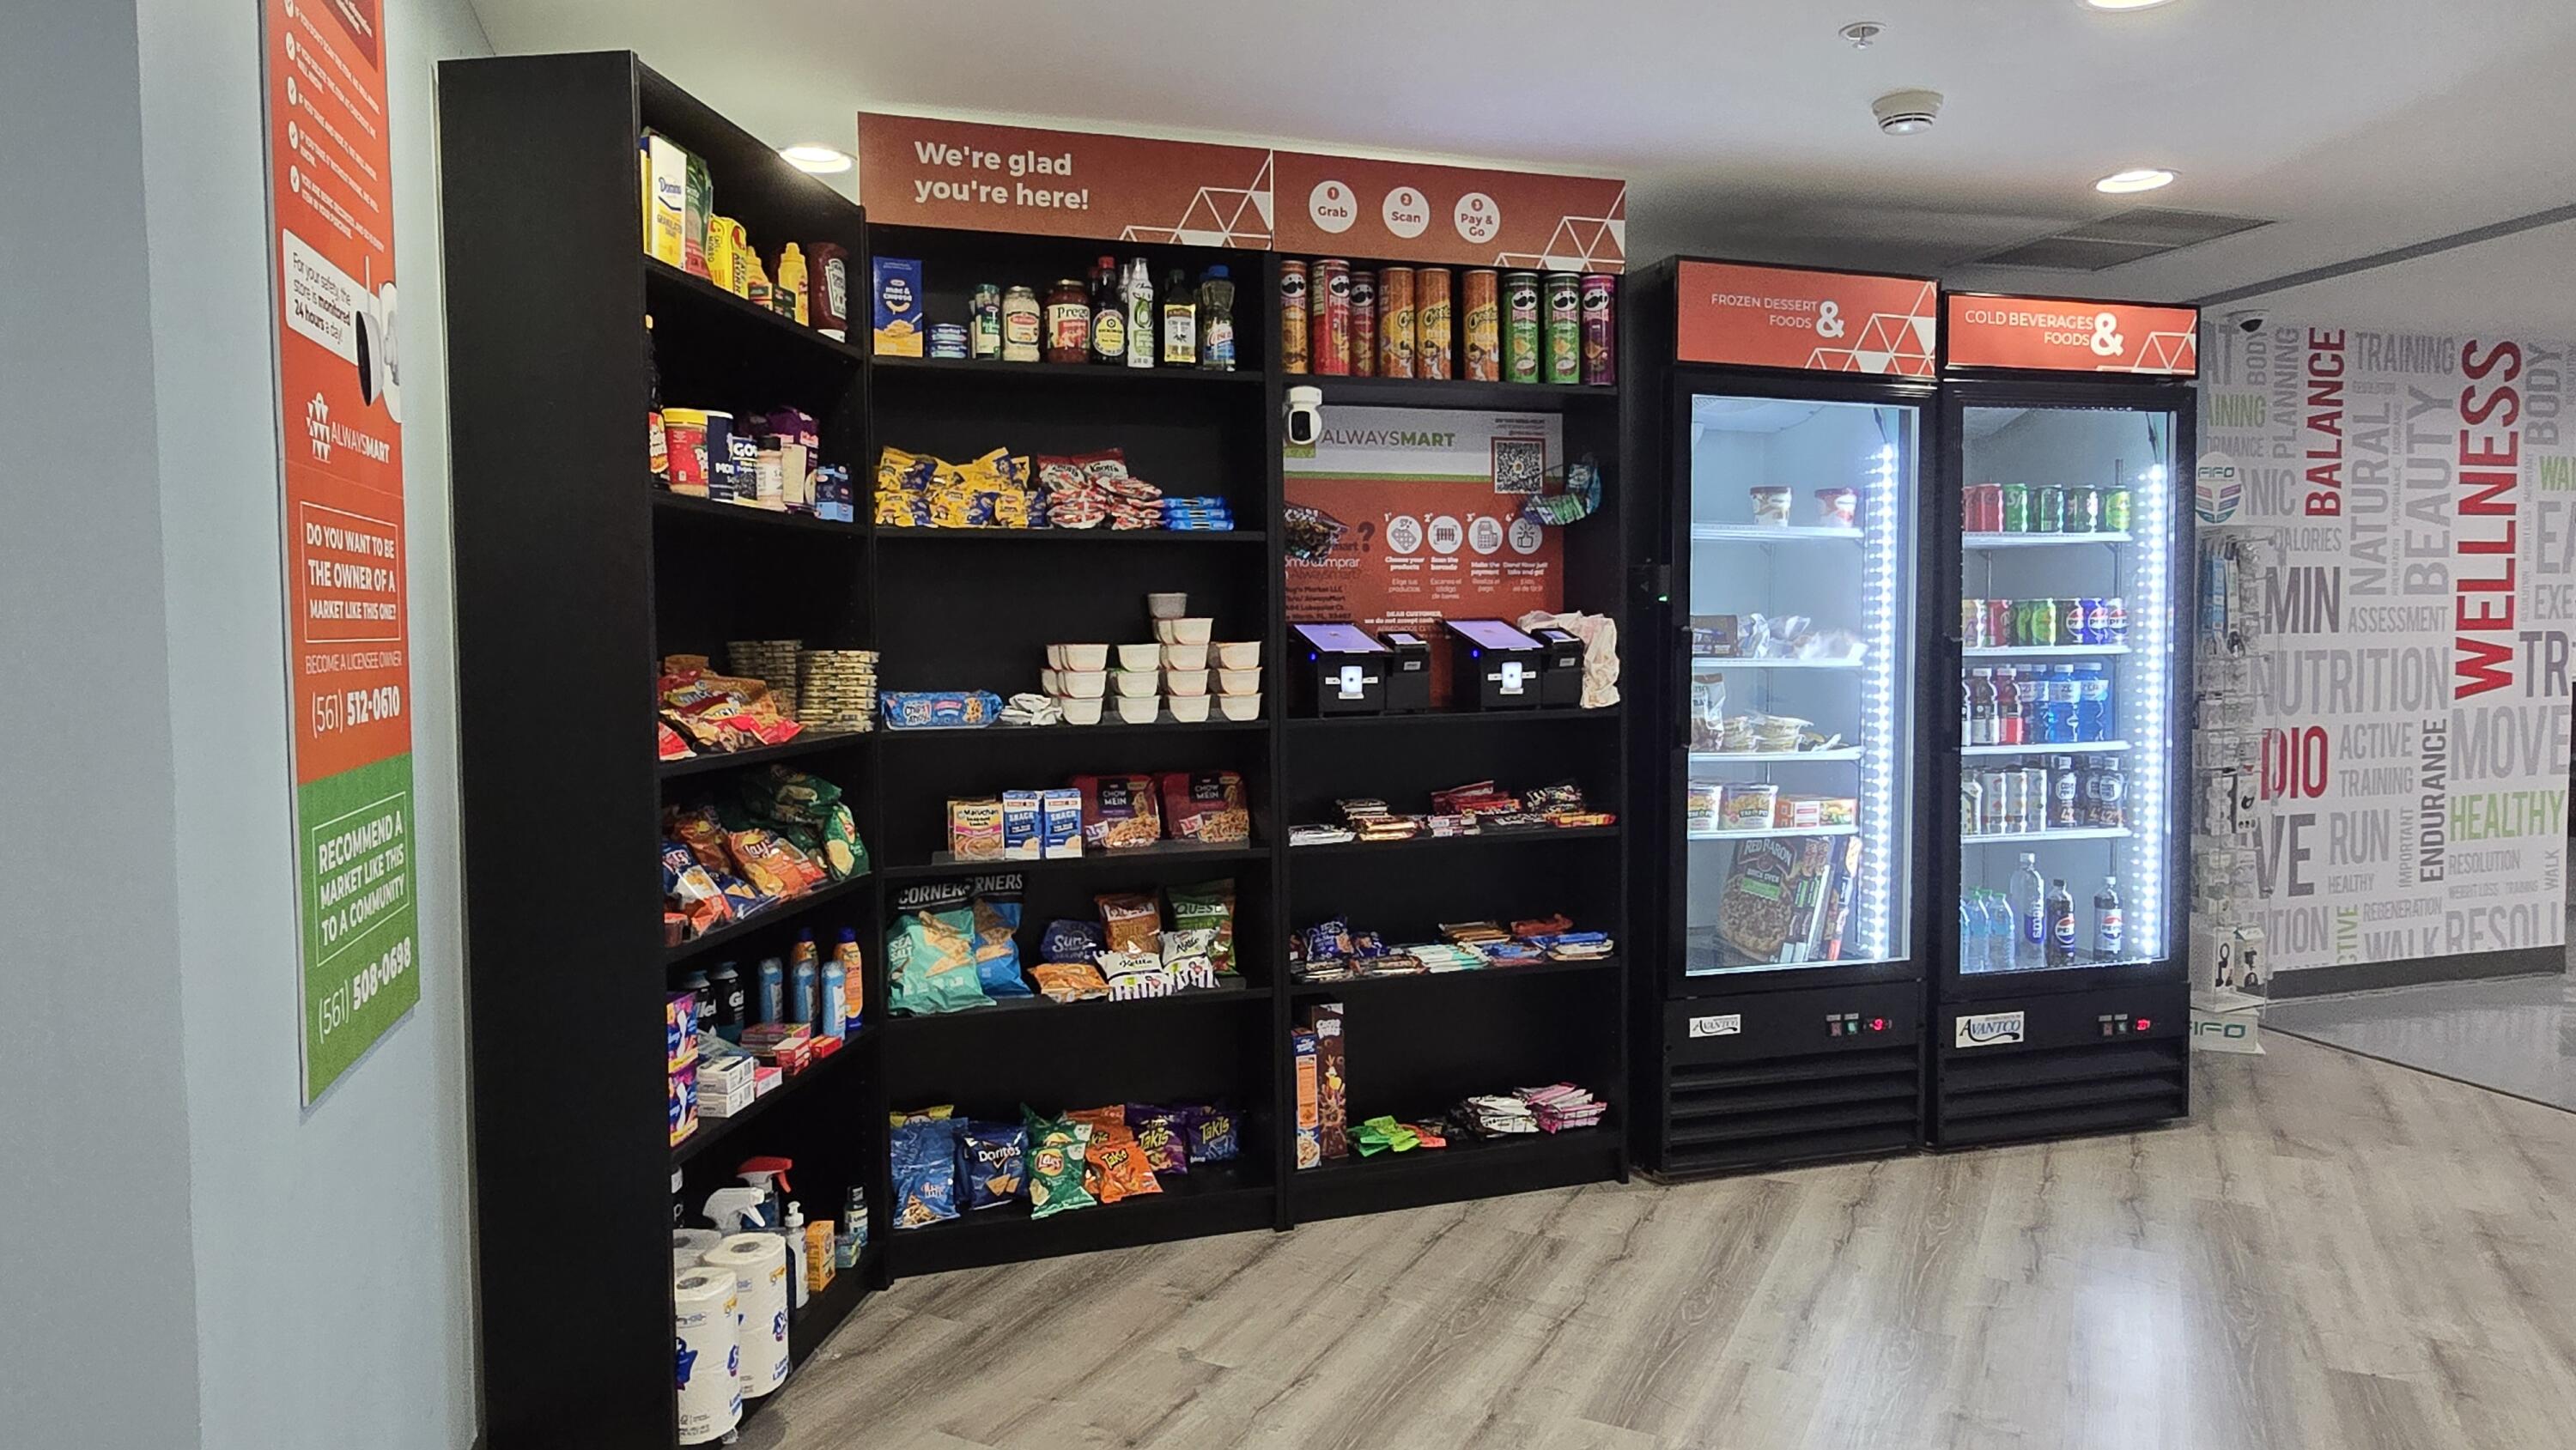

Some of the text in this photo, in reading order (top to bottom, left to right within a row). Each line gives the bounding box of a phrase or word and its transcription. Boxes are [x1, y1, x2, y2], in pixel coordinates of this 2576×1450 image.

[914, 141, 1072, 177] We're glad
[914, 180, 1089, 210] you're here!
[1318, 206, 1348, 218] Grab
[1391, 211, 1421, 223] Scan
[1461, 214, 1493, 227] Pay &
[1469, 227, 1485, 237] Go
[293, 252, 304, 273] For
[294, 298, 304, 319] 24
[1057, 306, 1089, 320] Prego
[1711, 294, 1844, 338] FROZEN DESSERT &
[1769, 314, 1812, 329] FOODS
[1965, 310, 2124, 356] COLD BEVERAGES &
[2044, 331, 2090, 346] FOODS
[2355, 331, 2455, 375] TRAINING
[2272, 327, 2300, 458] PLANNING
[2524, 342, 2563, 446] BODY
[2305, 327, 2345, 517] BALANCE
[331, 421, 390, 464] ALWAYSMART
[1321, 429, 1455, 447] ALWAYSMART
[2198, 466, 2235, 478] FIFO
[2348, 401, 2391, 596] NATURAL
[2403, 385, 2454, 595] BEAUTY
[2454, 339, 2522, 701] WELLNESS
[307, 522, 395, 559] DO YOU WANT TO BE
[308, 559, 396, 592] THE OWNER OF A
[310, 599, 396, 620] MARKET LIKE THIS ONE?
[2348, 606, 2448, 634] ASSESSMENT
[305, 653, 340, 675] BECOME
[340, 654, 346, 670] A
[379, 650, 402, 668] OWNER
[2250, 646, 2450, 718] NUTRITION
[312, 685, 400, 739] (561) 512-0610
[2338, 722, 2414, 761] ACTIVE
[2450, 704, 2570, 781] MOVE
[1194, 784, 1220, 792] CHOW
[2338, 767, 2414, 798] TRAINING
[2420, 718, 2447, 883] ENDURANCE
[2450, 789, 2566, 842] HEALTHY
[319, 810, 403, 875] RECOMMEND A
[1744, 838, 1792, 866] RED BARON
[2329, 809, 2391, 866] RUN
[2398, 806, 2414, 889] IMPORTANT
[320, 843, 404, 910] MARKET LIKE THIS
[2448, 849, 2521, 876] RESOLUTION
[2544, 847, 2561, 891] WALK
[2328, 872, 2375, 895] HEALTHY
[321, 872, 404, 946] TO A COMMUNITY
[2363, 896, 2442, 923] REGENERATION
[891, 936, 913, 949] SEA
[319, 936, 411, 1045] (561) 508-0698
[1959, 1018, 2020, 1041] AVANTCO
[1139, 1127, 1170, 1149] Takis
[1200, 1116, 1230, 1144] Takis
[978, 1145, 1021, 1162] Doritos
[1101, 1149, 1128, 1170] Takis
